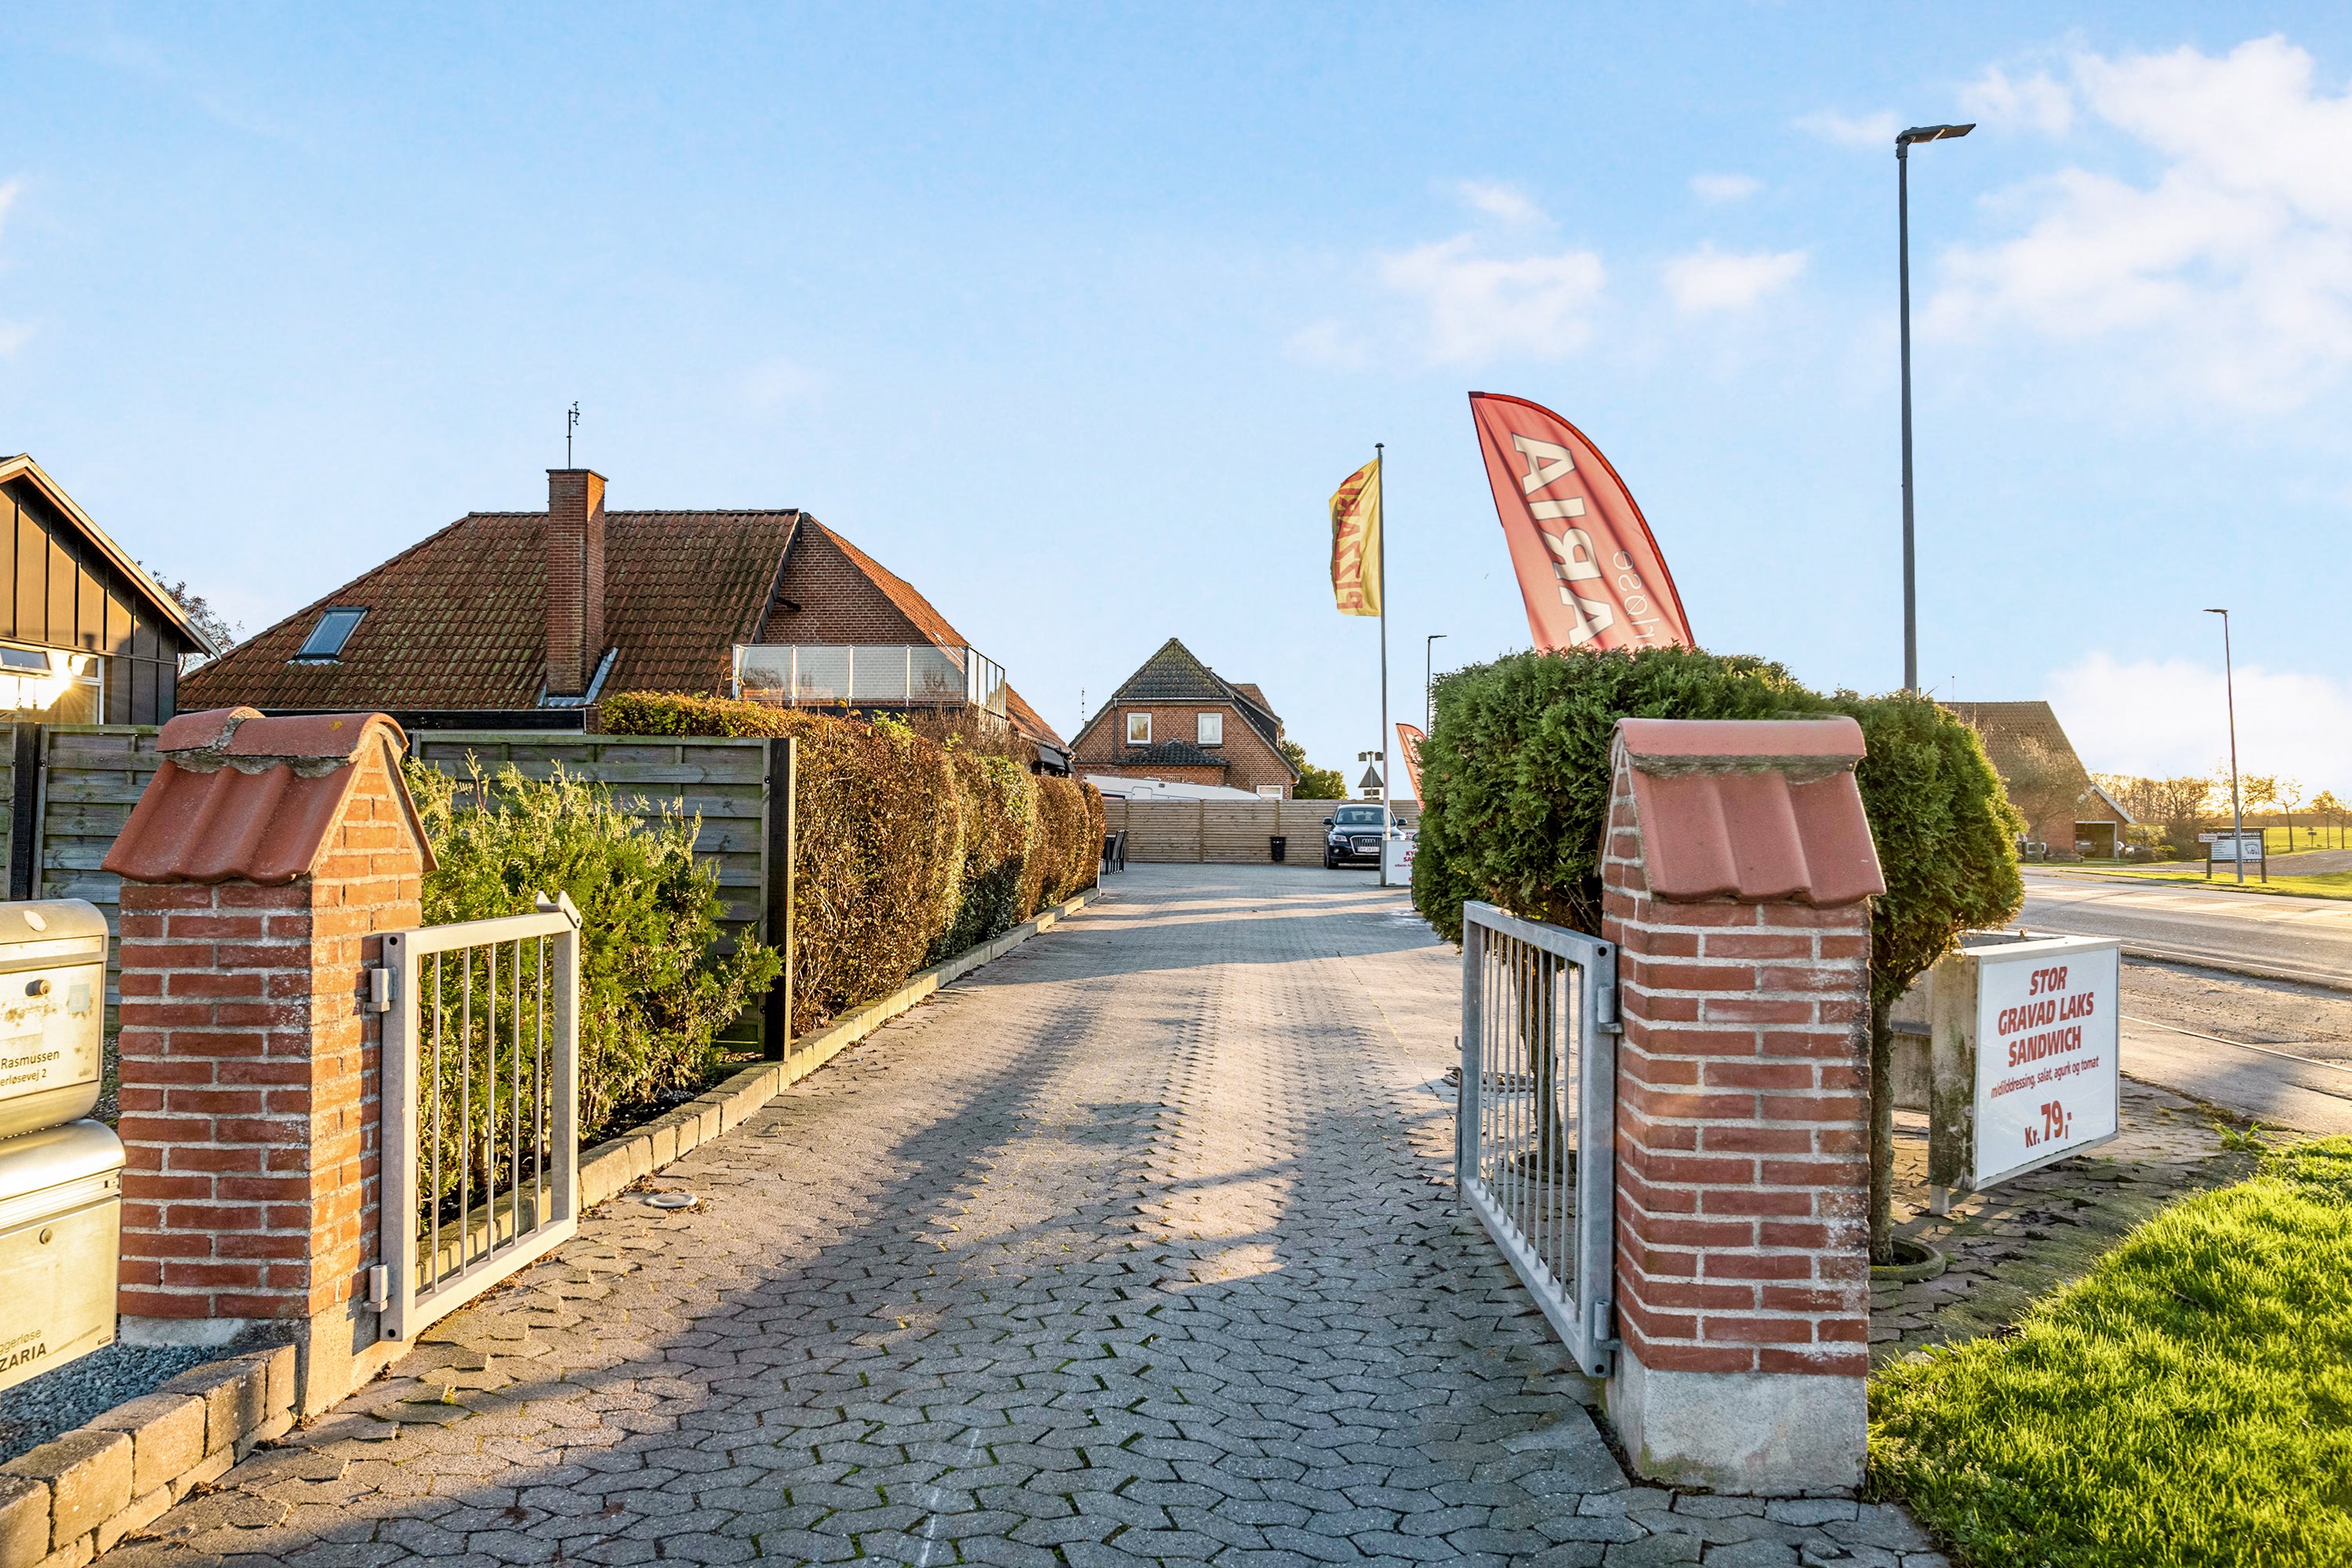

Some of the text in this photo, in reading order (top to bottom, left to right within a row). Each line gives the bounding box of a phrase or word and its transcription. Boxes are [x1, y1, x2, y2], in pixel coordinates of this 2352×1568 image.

[2029, 965, 2067, 996] STOR
[1998, 992, 2094, 1036] GRAVAD LAKS
[1, 1051, 60, 1069] Rasmussen
[2008, 1025, 2082, 1068] SANDWICH
[42, 1068, 47, 1079] 2
[2054, 1061, 2071, 1081] agurk
[2072, 1062, 2080, 1076] og
[2081, 1055, 2100, 1071] tomat
[2024, 1126, 2040, 1149] Kr.
[0, 1342, 46, 1373] ZARIA
